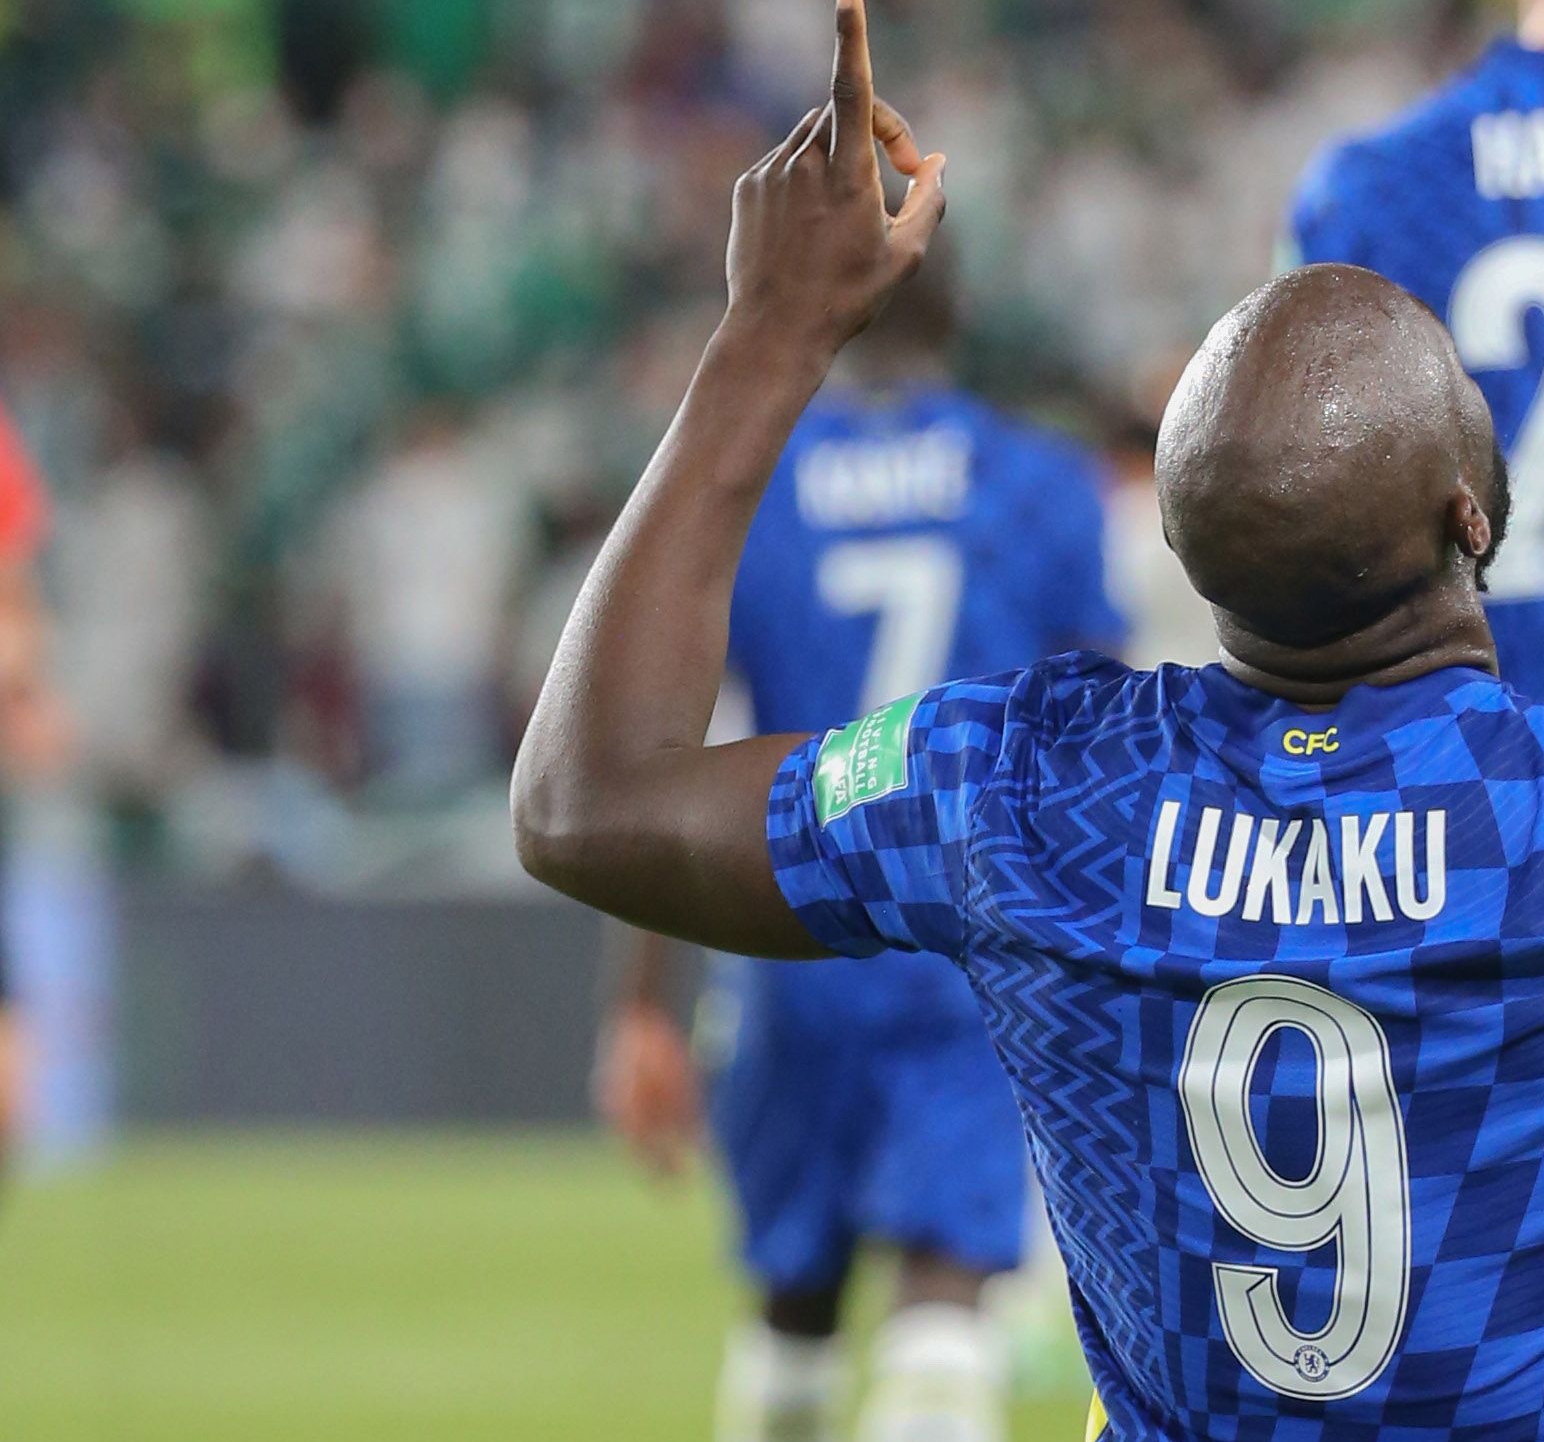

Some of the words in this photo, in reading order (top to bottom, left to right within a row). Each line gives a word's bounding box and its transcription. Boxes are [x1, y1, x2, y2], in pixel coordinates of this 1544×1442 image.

[815, 533, 964, 719] 7
[1282, 726, 1340, 755] CFC
[1146, 800, 1447, 925] LUKAKU
[1178, 973, 1412, 1402] 9
